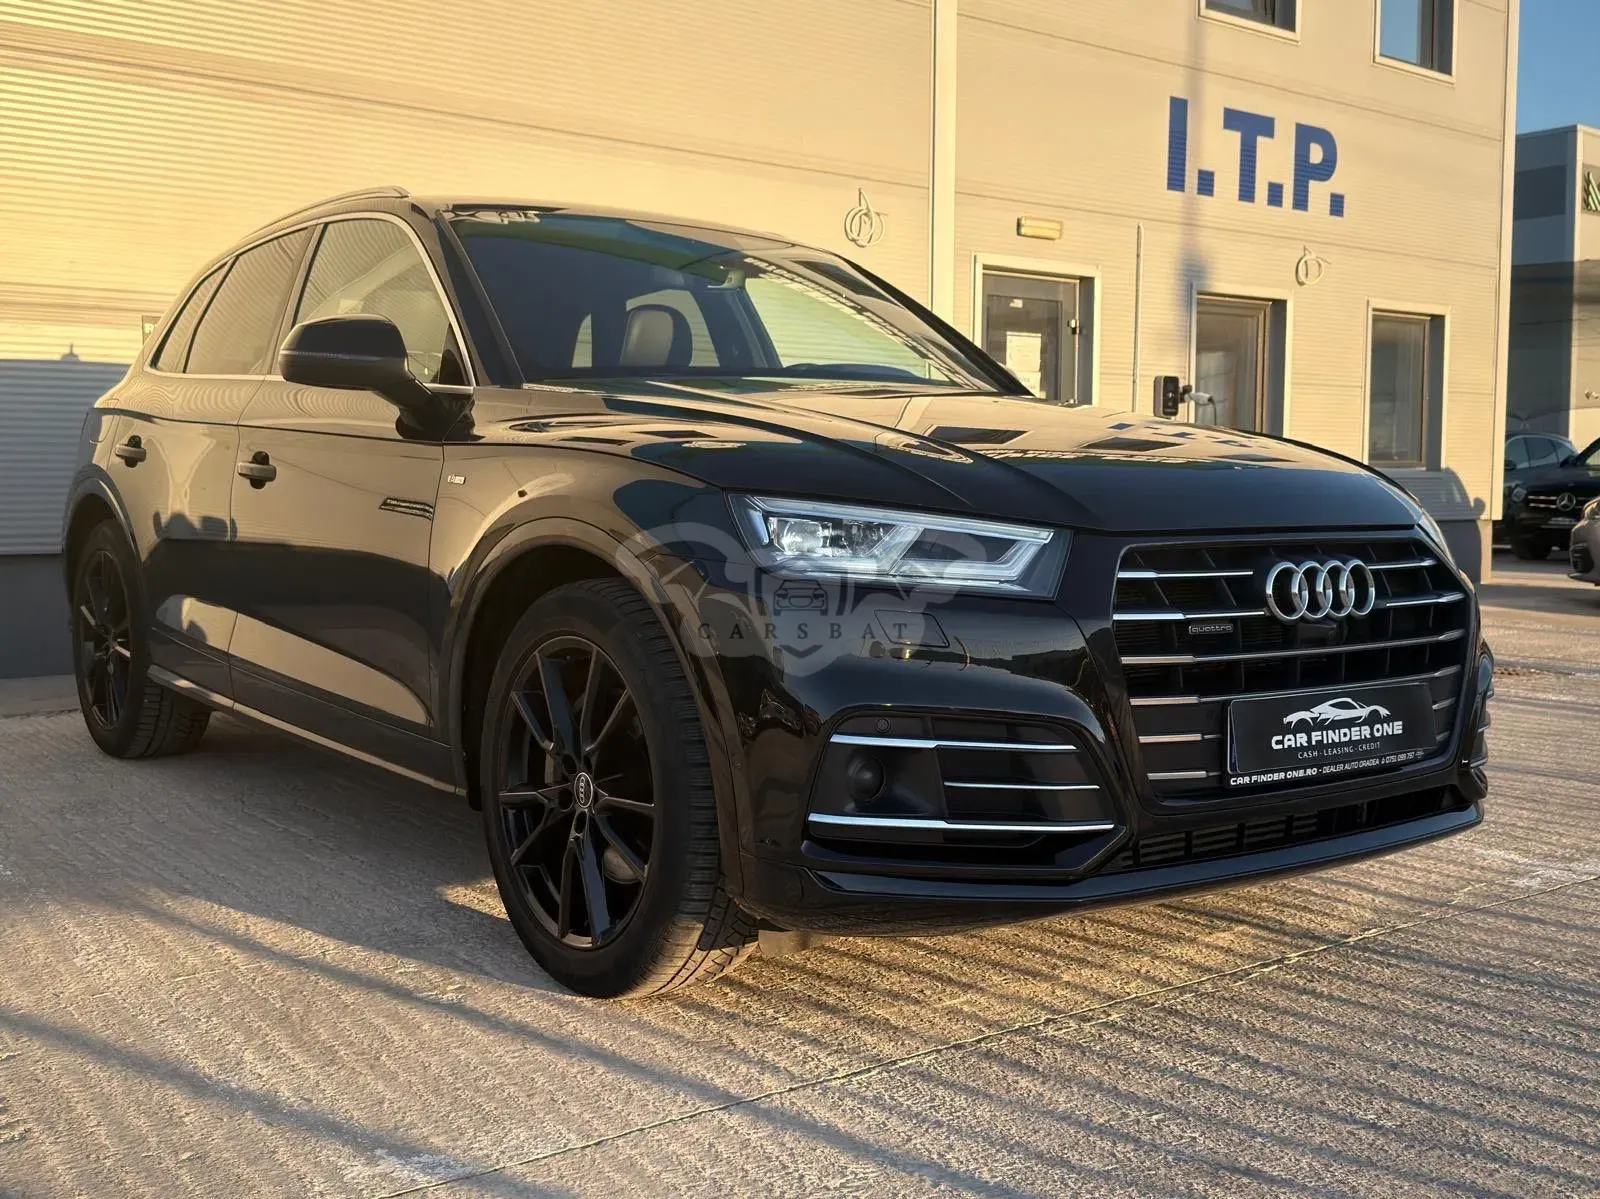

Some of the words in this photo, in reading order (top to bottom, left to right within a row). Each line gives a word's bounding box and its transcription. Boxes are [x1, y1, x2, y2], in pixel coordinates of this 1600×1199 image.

[1167, 96, 1345, 217] I.T.P.
[1191, 625, 1232, 633] quattro
[1271, 733, 1308, 750] CAR
[1311, 726, 1371, 744] FINDER
[1373, 721, 1403, 737] ONE
[1298, 750, 1318, 759] CASH
[1323, 745, 1354, 756] LEASING
[1358, 741, 1381, 752] CREDIT
[1230, 777, 1250, 786] CAR
[1251, 772, 1285, 784] FINDER
[1286, 767, 1318, 779] ONE.RO
[1322, 763, 1344, 774] DEALER
